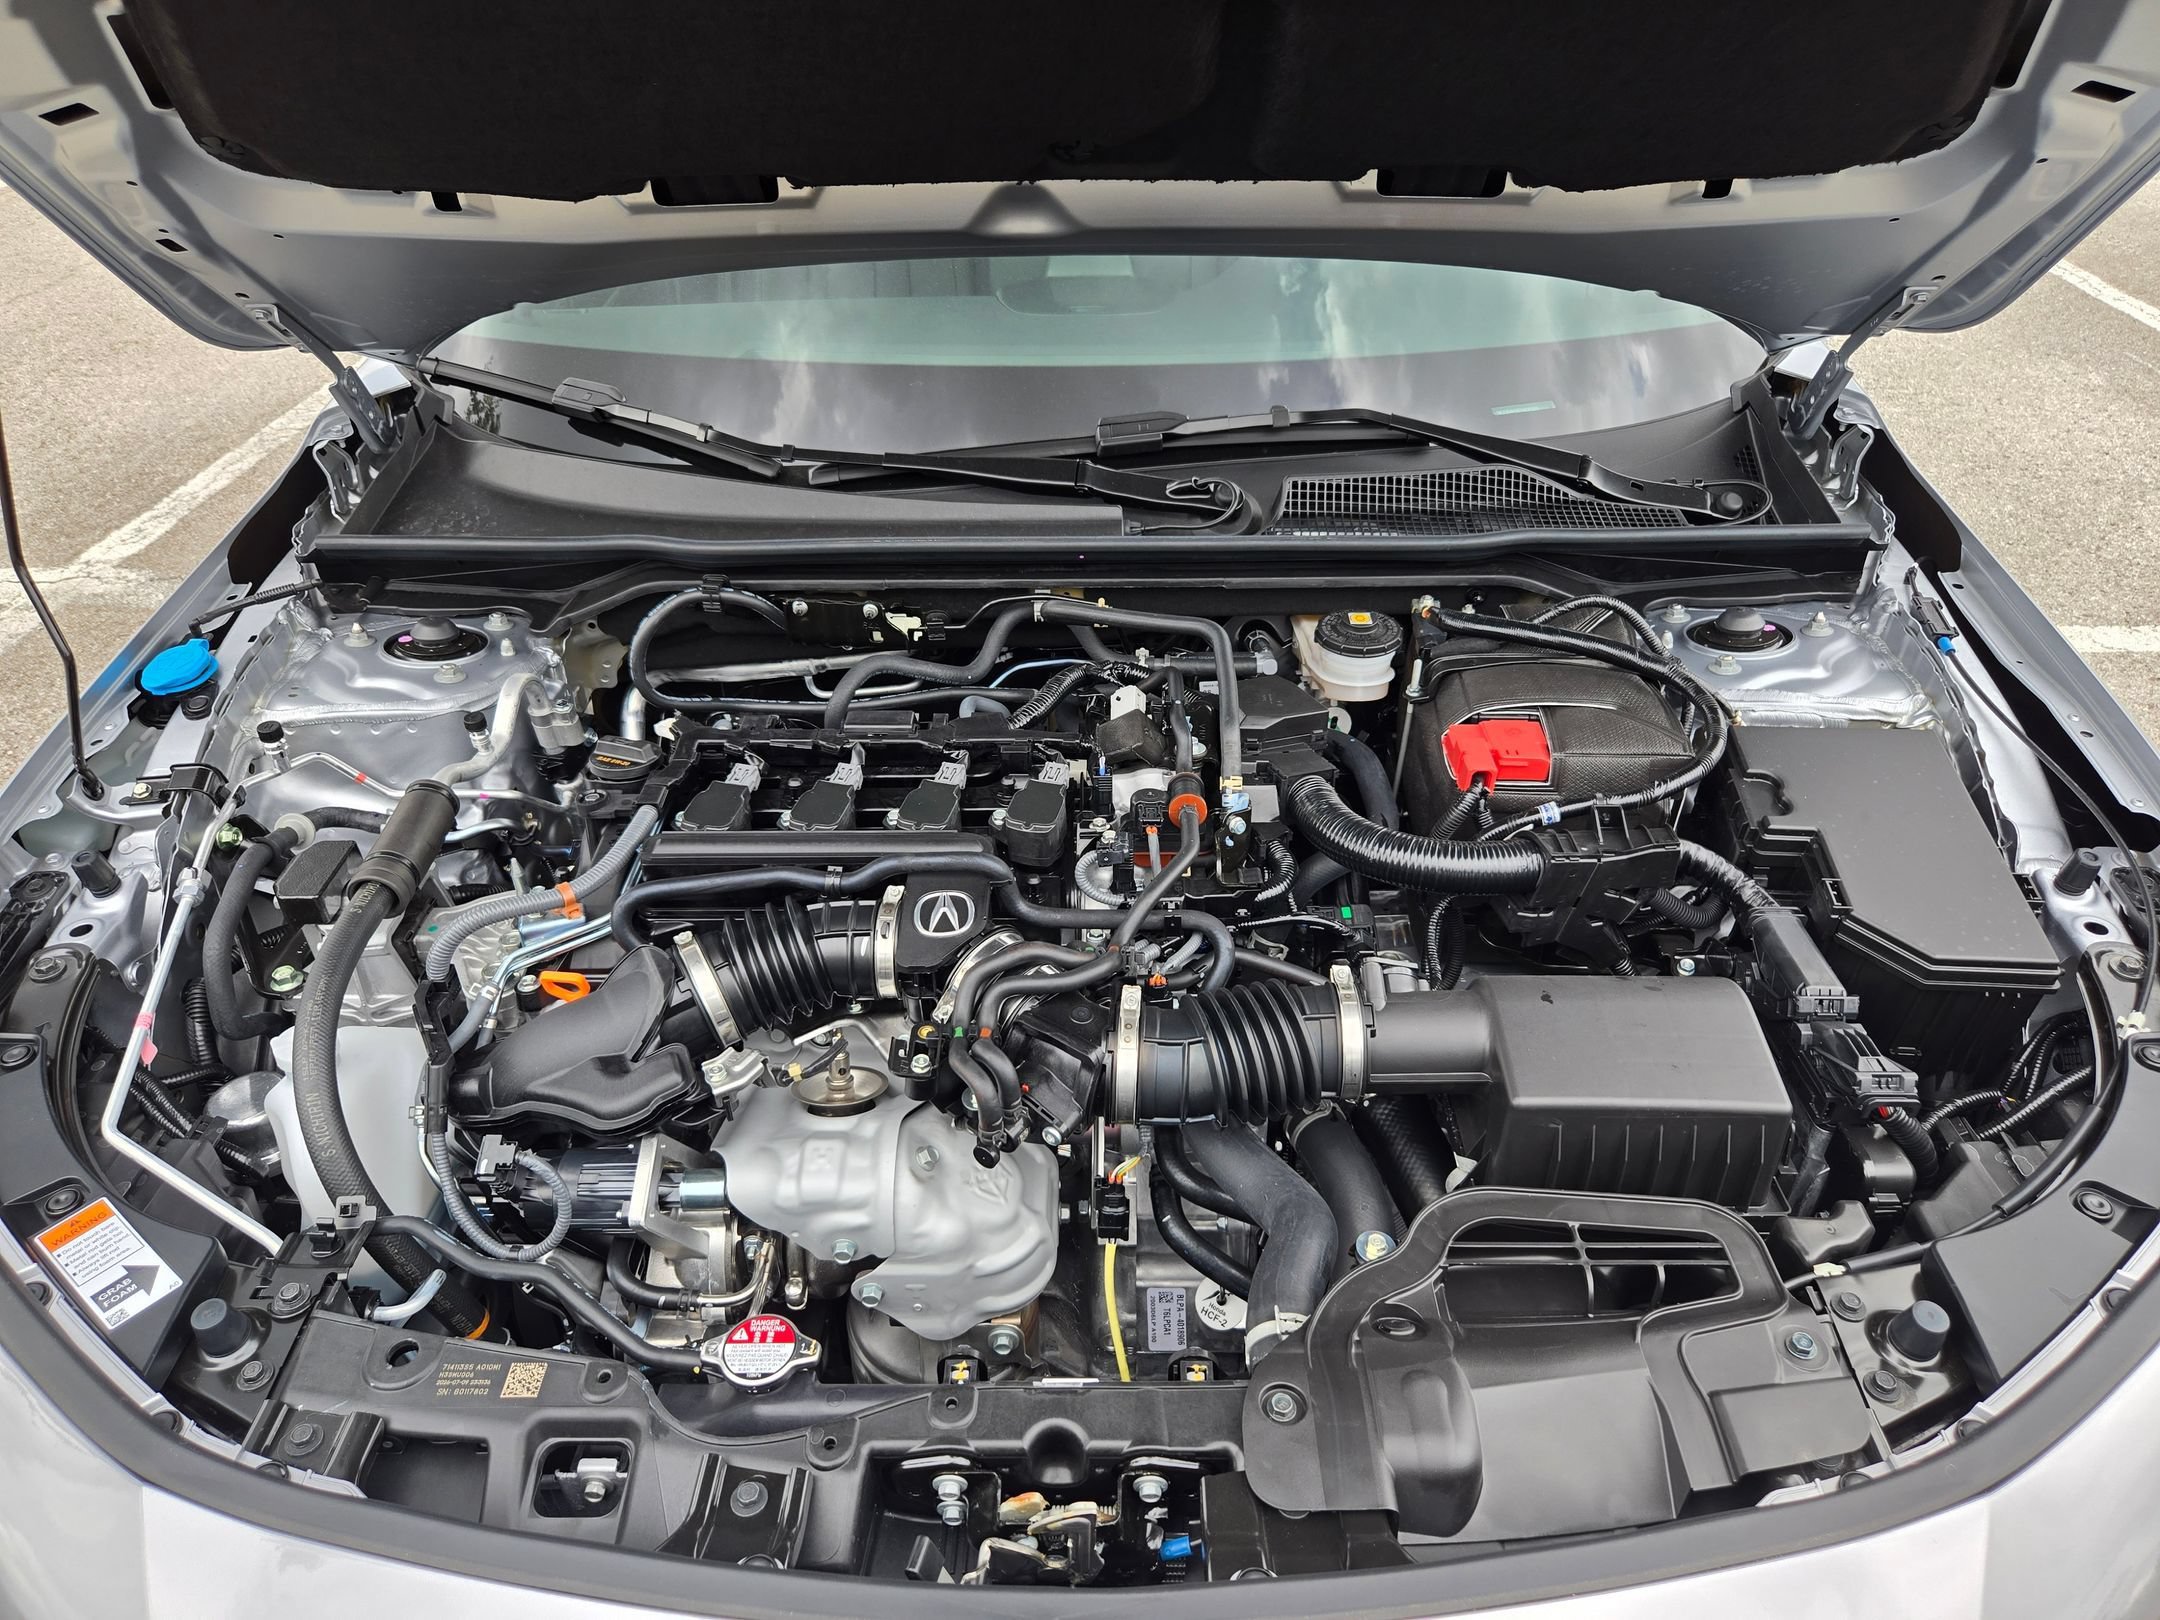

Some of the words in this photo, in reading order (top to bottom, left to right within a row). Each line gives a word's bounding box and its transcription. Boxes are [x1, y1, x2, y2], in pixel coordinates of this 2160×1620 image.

[50, 1212, 108, 1246] WARNING
[98, 1277, 133, 1301] GRAB
[103, 1283, 138, 1308] FOAM
[1200, 1306, 1228, 1328] HCF-2
[1208, 1302, 1226, 1316] Honda
